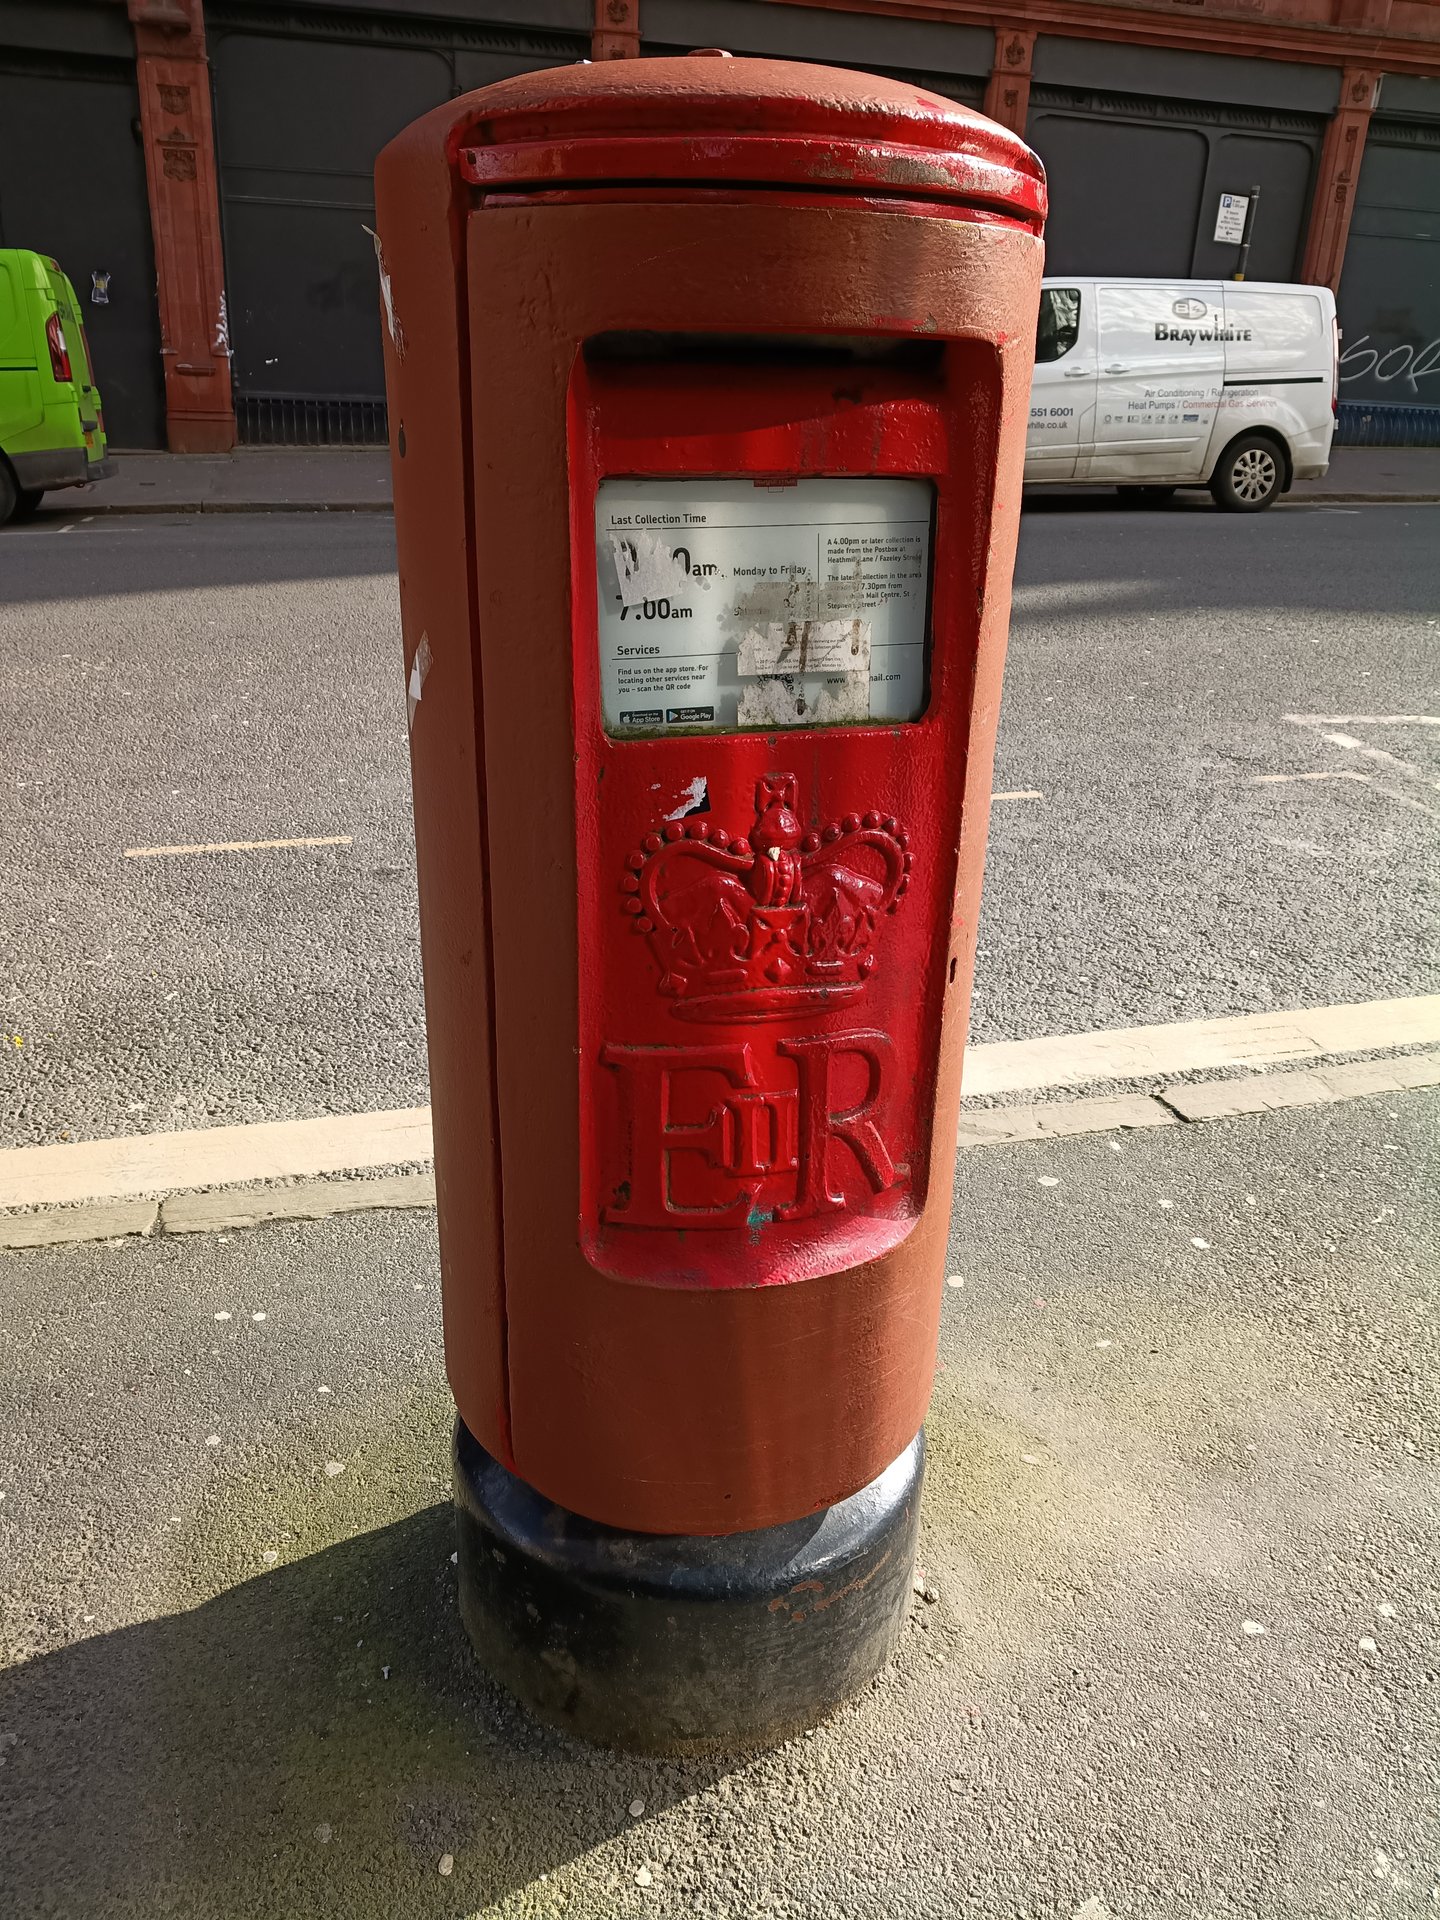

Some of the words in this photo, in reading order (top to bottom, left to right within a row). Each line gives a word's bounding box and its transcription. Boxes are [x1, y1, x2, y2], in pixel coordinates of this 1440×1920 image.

[1223, 196, 1232, 208] P
[1144, 389, 1156, 398] Air
[1158, 389, 1205, 399] Conditioning
[1128, 401, 1147, 410] Heat
[1148, 401, 1176, 411] Pumps
[1228, 400, 1244, 408] Gas
[1246, 399, 1278, 408] Services
[1030, 408, 1048, 416] 551
[1050, 408, 1074, 416] 6001
[611, 516, 632, 524] Last
[635, 514, 681, 524] Collection
[683, 514, 706, 523] Time
[834, 538, 860, 546] 4.00pm
[734, 566, 766, 576] Monday
[769, 566, 778, 574] to
[780, 565, 806, 575] Friday
[617, 645, 660, 656] Services
